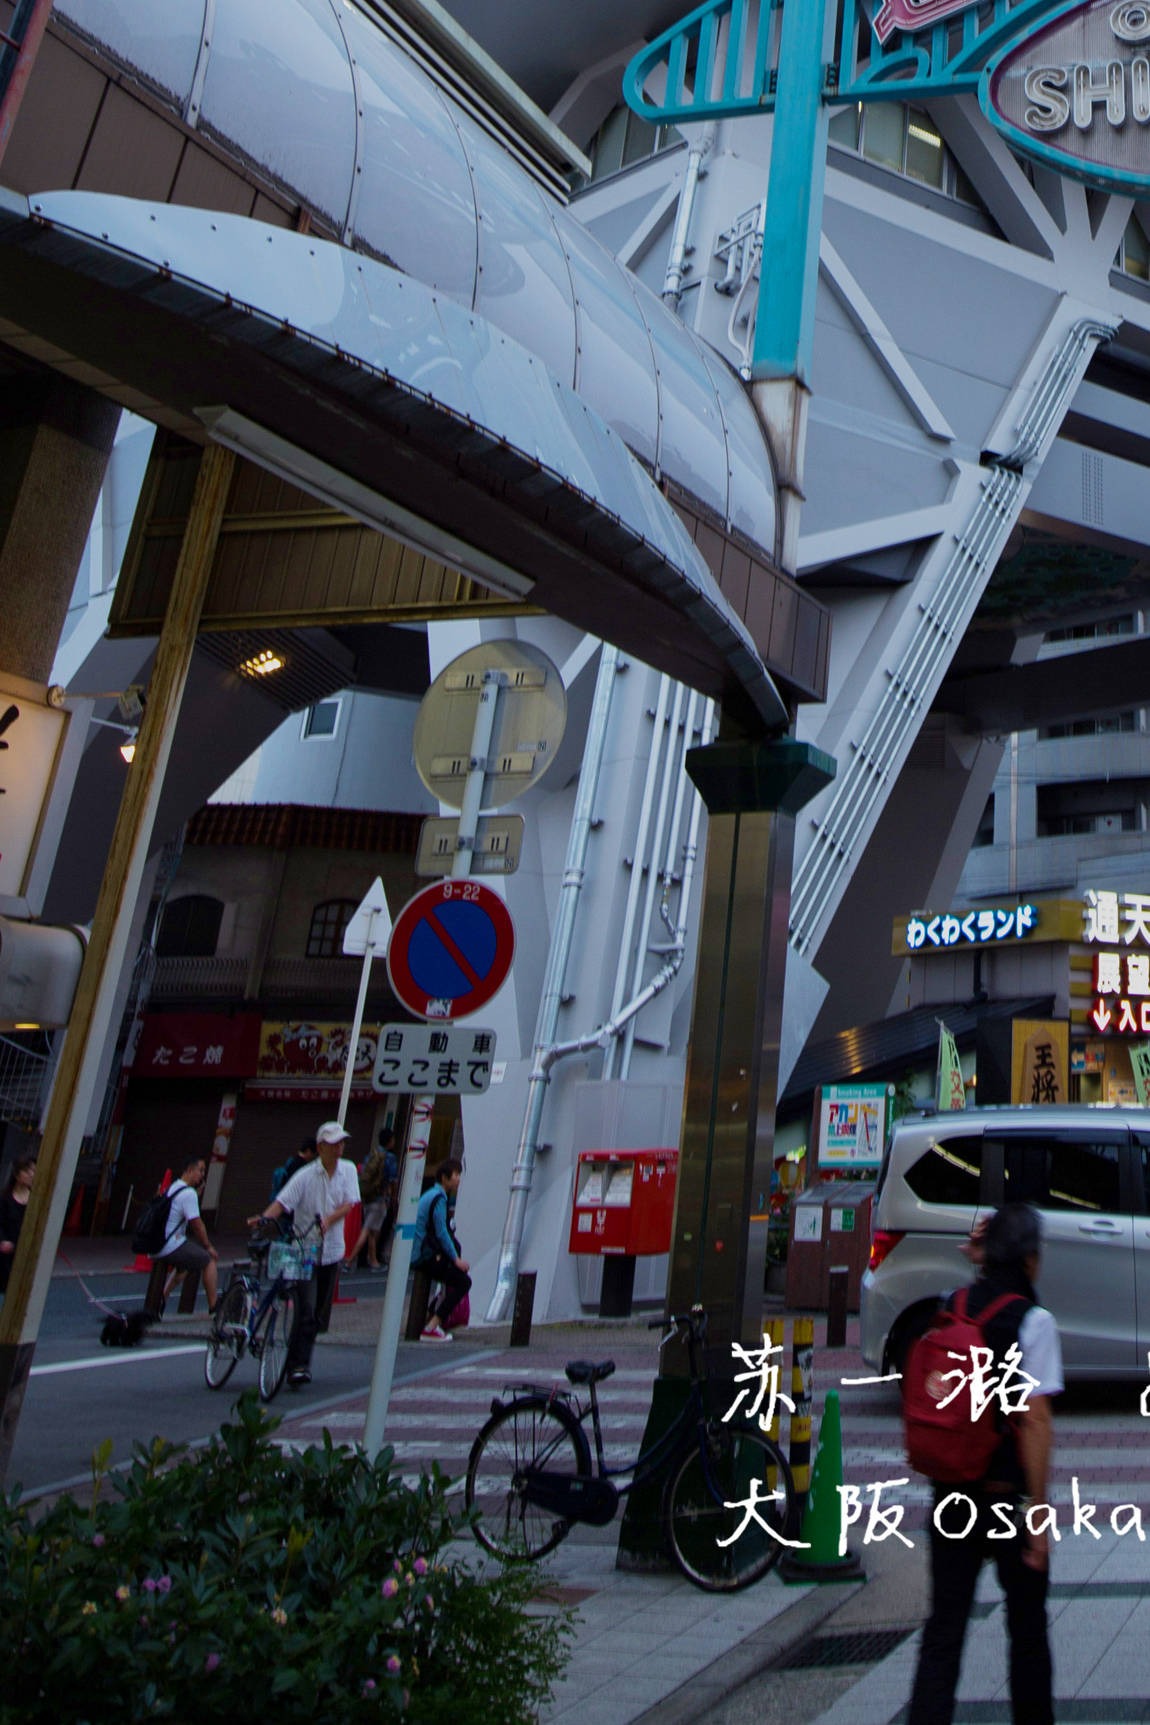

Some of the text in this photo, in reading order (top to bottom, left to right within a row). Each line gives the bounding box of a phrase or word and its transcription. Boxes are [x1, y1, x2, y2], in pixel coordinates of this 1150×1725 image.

[443, 883, 480, 900] 9-22
[906, 904, 1035, 949] わくわくランド
[152, 1044, 224, 1065] たこ焼
[384, 1030, 492, 1055] 自動車
[378, 1059, 489, 1089] ここまで
